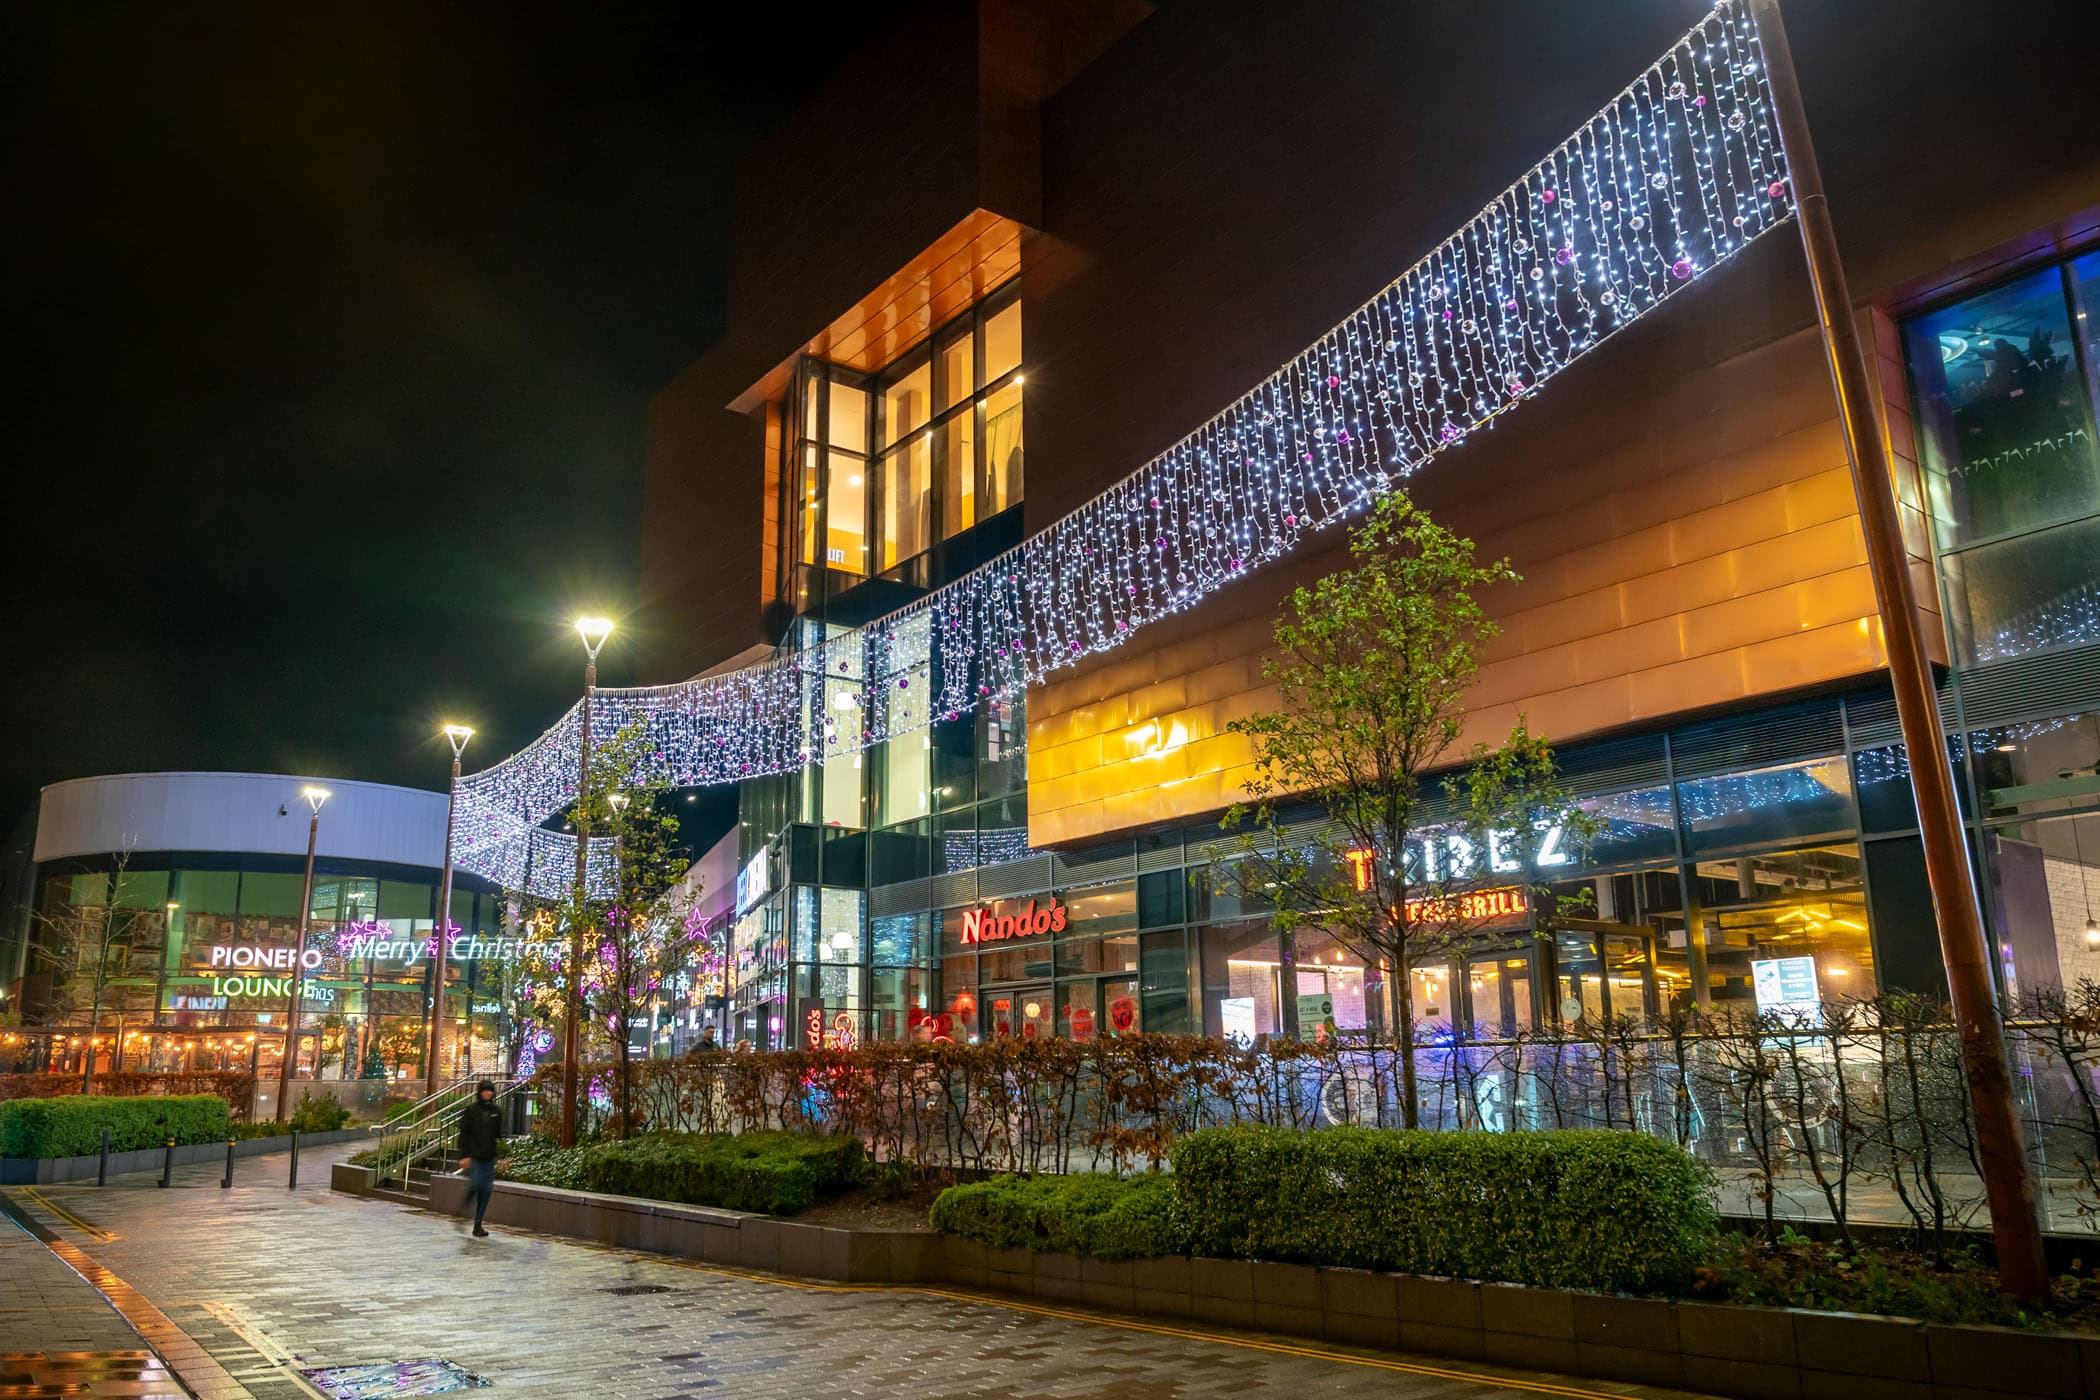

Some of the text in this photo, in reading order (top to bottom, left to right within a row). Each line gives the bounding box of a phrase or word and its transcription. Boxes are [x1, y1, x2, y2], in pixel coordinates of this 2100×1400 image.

[1461, 890, 1526, 919] GRILL
[960, 898, 1066, 944] Nando's
[212, 946, 322, 969] PIONERO
[350, 936, 425, 966] Merry
[213, 977, 317, 998] LOUNGE
